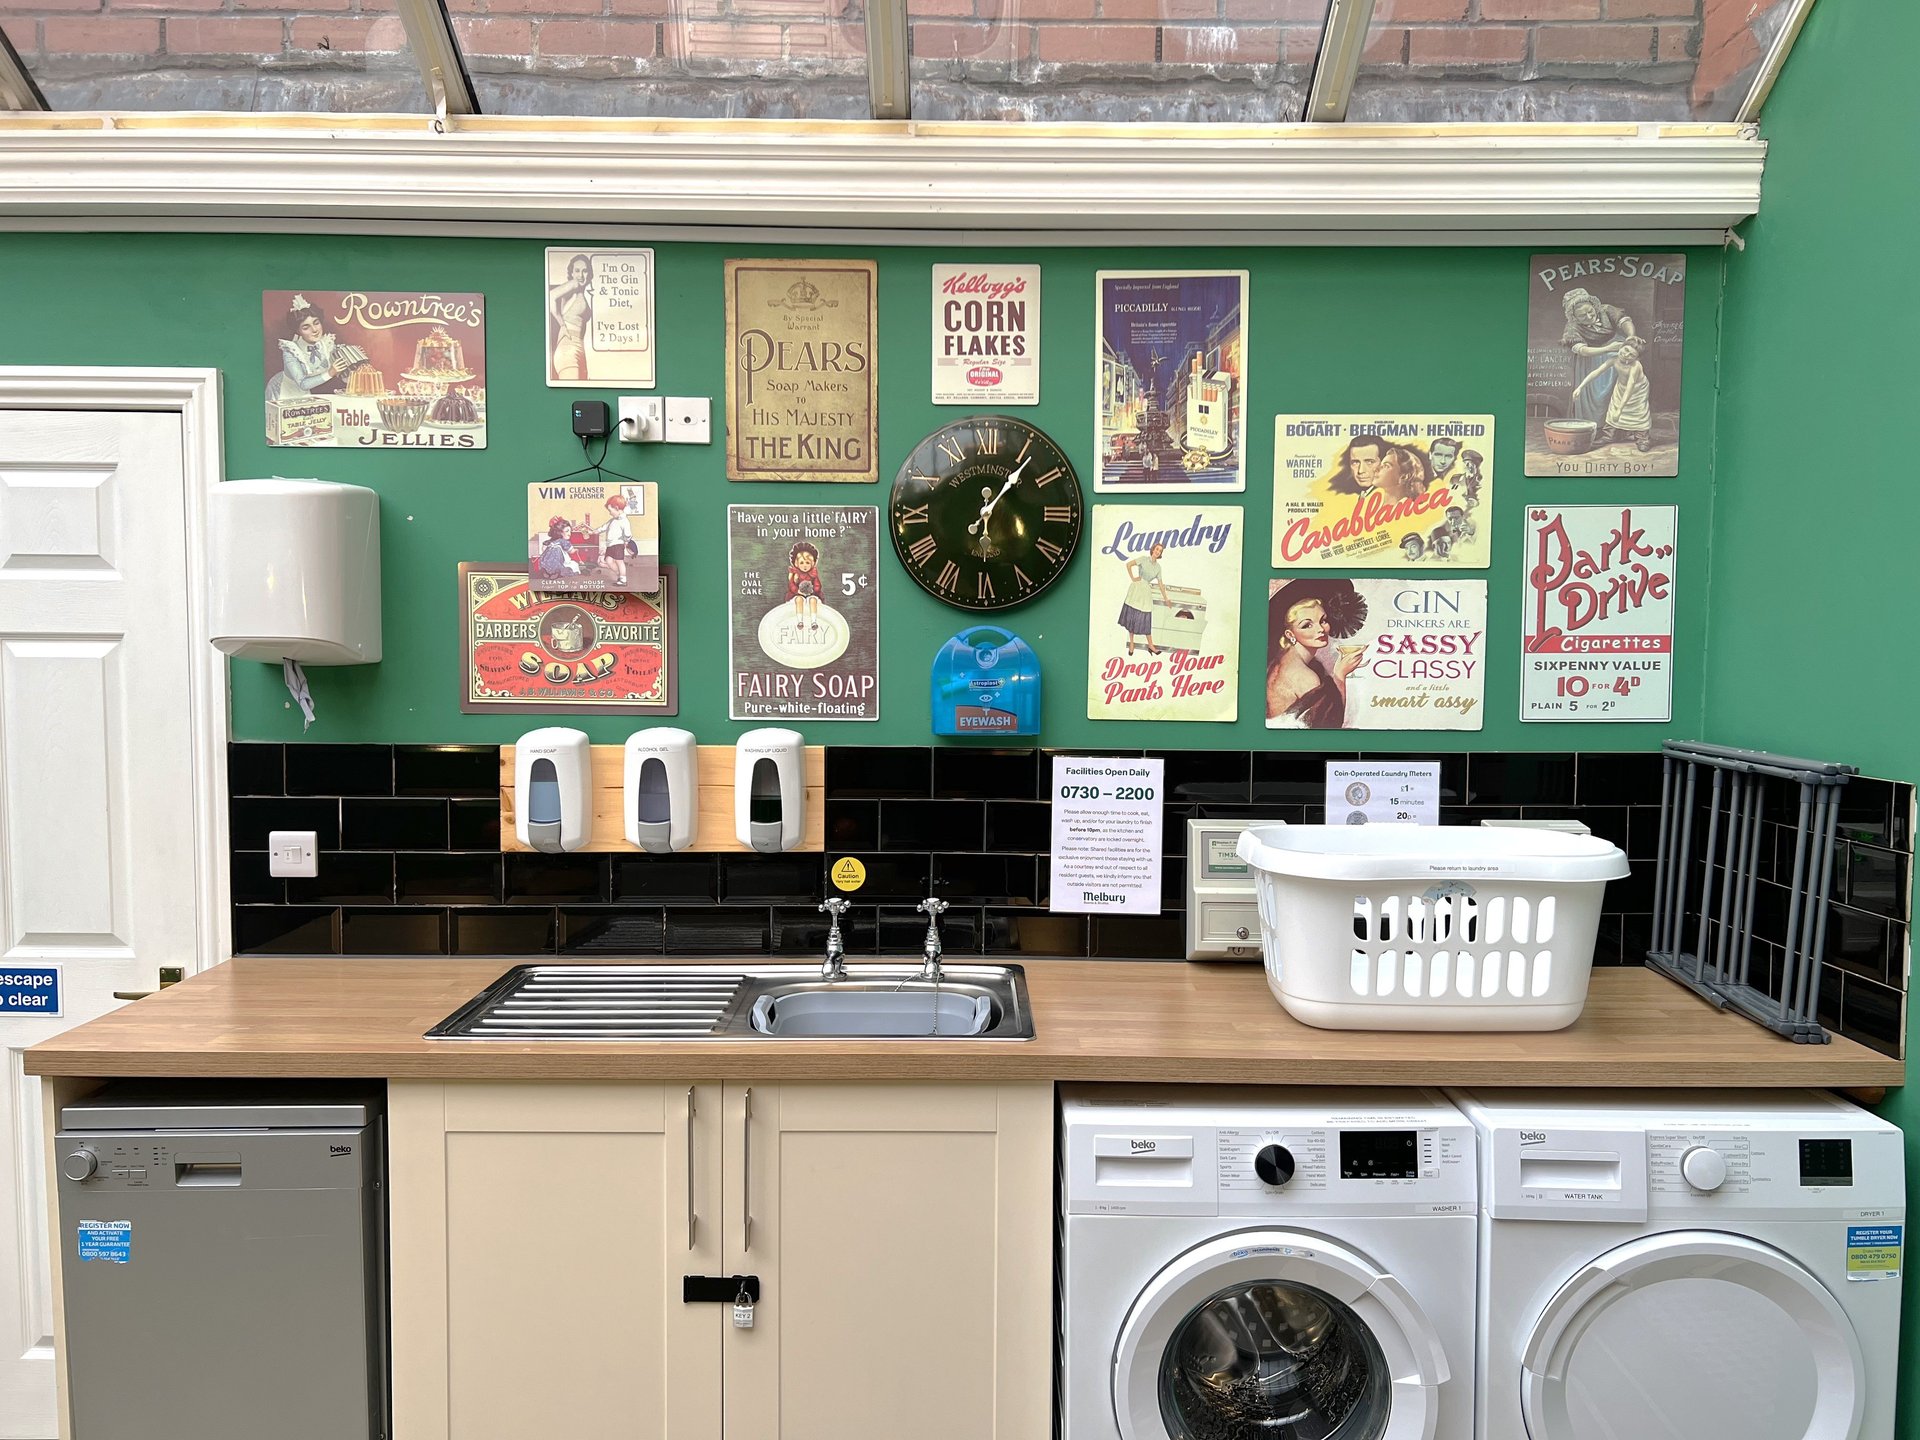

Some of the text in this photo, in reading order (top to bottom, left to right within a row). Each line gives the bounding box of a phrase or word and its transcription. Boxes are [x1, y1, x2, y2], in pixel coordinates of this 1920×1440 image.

[603, 263, 635, 272] I'm On
[1539, 256, 1684, 291] PEARS' SOAP
[600, 275, 638, 284] The Gin
[943, 272, 1026, 299] Kellogg's
[600, 287, 639, 295] & Tonic
[334, 293, 481, 329] Rowntree's
[609, 299, 632, 309] Diet,
[1115, 303, 1168, 312] PICCADILLY
[795, 315, 824, 323] Special
[945, 300, 1025, 332] CORN
[598, 322, 639, 330] I've Lost
[788, 323, 819, 331] Warrant
[600, 334, 633, 344] 2 Days
[945, 335, 1025, 356] FLAKES
[740, 329, 866, 407] PEARS
[767, 380, 848, 393] Soap Makers
[337, 409, 370, 426] Table
[753, 409, 854, 426] HIS MAJESTY
[1286, 424, 1485, 437] BOGART BERGMAN HENREID
[359, 429, 474, 447] JELLIES
[976, 429, 998, 455] XII
[746, 434, 861, 460] THE KING
[938, 437, 966, 466] XI
[1287, 459, 1322, 468] WARNER
[1556, 462, 1579, 473] YOU
[1586, 462, 1619, 473] DIRTY
[1293, 469, 1316, 478] BROS.
[539, 488, 565, 499] VIM
[768, 513, 788, 525] you
[792, 514, 799, 523] a
[803, 512, 830, 523] little
[757, 527, 768, 536] in
[773, 528, 800, 539] your
[1102, 514, 1232, 561] Laundry
[1394, 591, 1460, 614] GIN
[1558, 563, 1670, 630] Drive
[1388, 620, 1470, 628] DRINKERS ARE
[476, 623, 660, 641] BARBERS FAVORITE
[778, 626, 830, 644] FAIRY
[1377, 631, 1482, 655] SASSY
[1561, 637, 1661, 653] Cigarettes
[518, 652, 618, 685] SOAP
[1101, 649, 1224, 683] Drop Your
[1373, 660, 1476, 678] CLASSY
[1534, 661, 1661, 670] SIXPENNY VALUE
[737, 673, 874, 698] FAIRY SOAP
[1105, 674, 1224, 704] Pants Here
[1557, 676, 1589, 697] 10
[744, 702, 865, 716] Pure-white-floating
[1371, 693, 1478, 715] smart assy
[1569, 701, 1578, 711] 5
[960, 717, 1010, 726] EYEWASH
[1129, 769, 1150, 777] Daily
[1061, 786, 1154, 800] 0730 2200
[1397, 812, 1411, 820] 20p
[1083, 892, 1125, 903] Melbury
[9, 992, 48, 1006] clear
[1520, 1132, 1546, 1140] beko
[1131, 1140, 1155, 1149] beko
